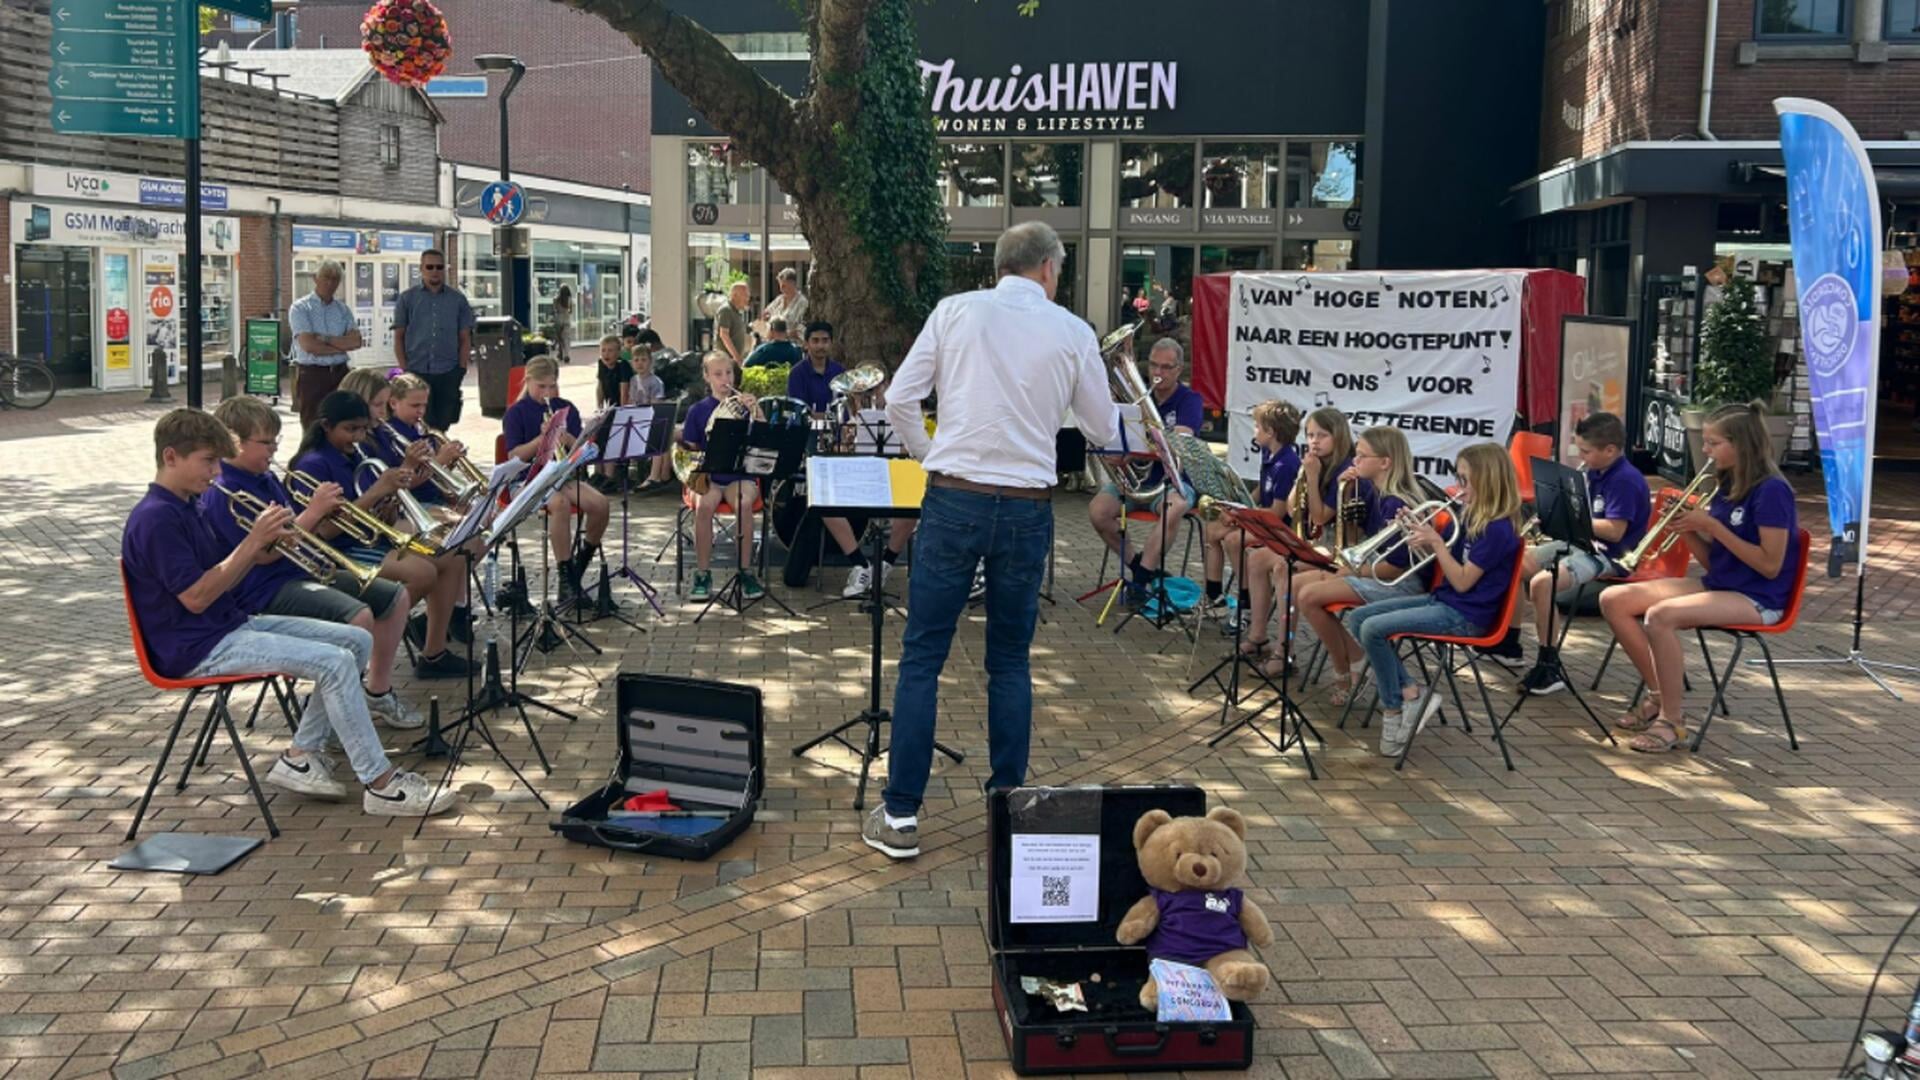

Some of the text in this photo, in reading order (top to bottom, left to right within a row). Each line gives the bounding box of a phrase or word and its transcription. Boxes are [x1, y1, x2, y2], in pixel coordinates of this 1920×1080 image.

[918, 58, 1178, 113] ThuisHAVEN
[935, 116, 1145, 131] WONEN & LIFESTYLE
[67, 172, 100, 192] Lyca
[141, 181, 159, 192] GSM
[65, 212, 96, 230] GSM
[1130, 212, 1180, 225] INGANG
[1204, 214, 1272, 225] VIA WINKEL
[1250, 289, 1488, 309] VAN HOGE NOTEN
[1235, 325, 1292, 346] NAAR
[1297, 329, 1340, 348] EEN
[1245, 365, 1473, 395] STEUN ONS VOOR
